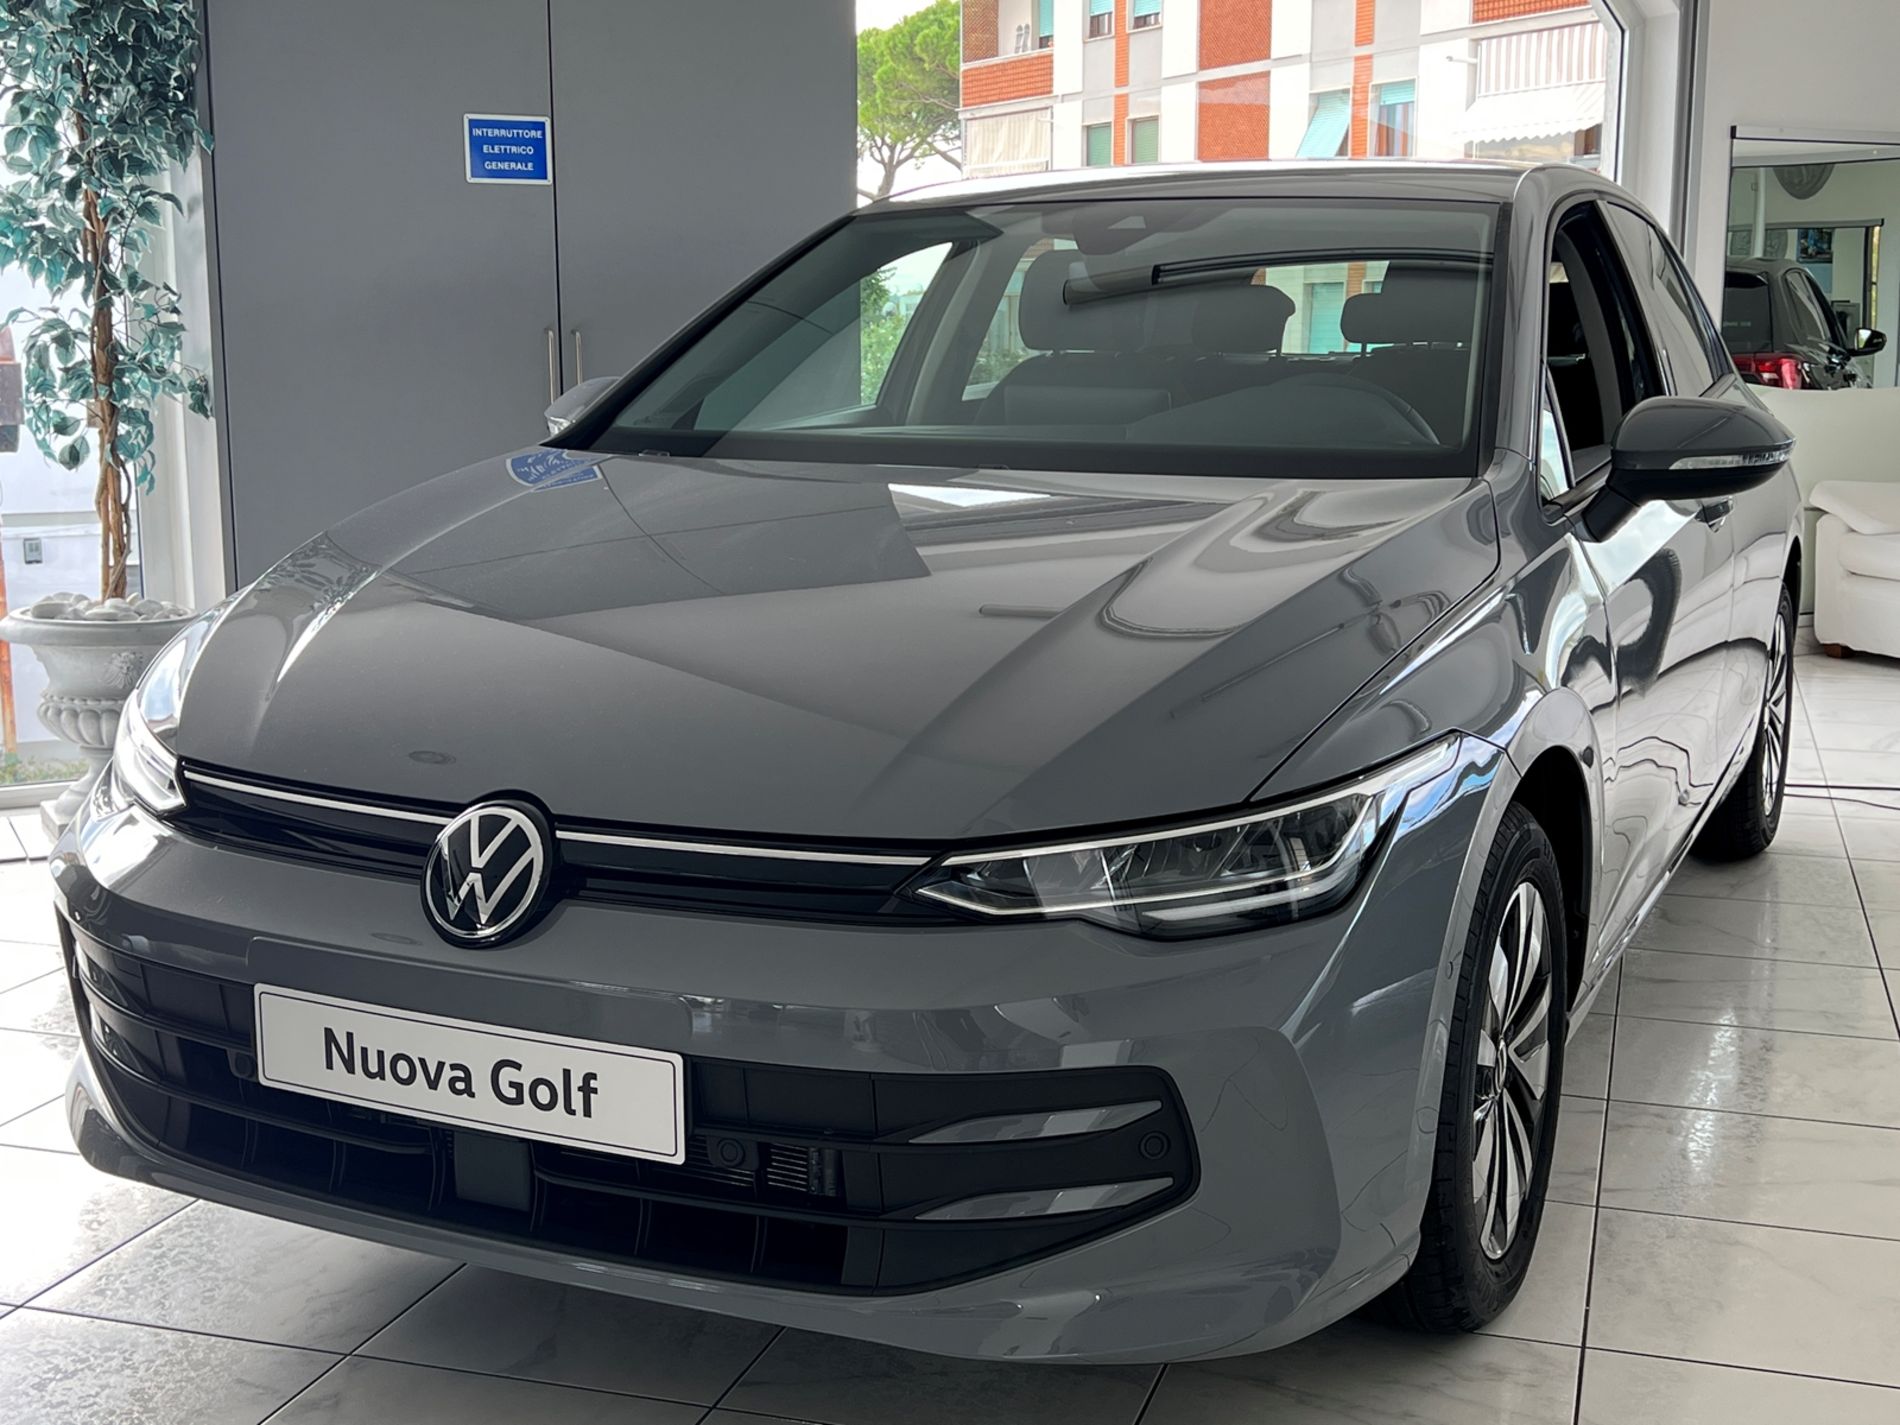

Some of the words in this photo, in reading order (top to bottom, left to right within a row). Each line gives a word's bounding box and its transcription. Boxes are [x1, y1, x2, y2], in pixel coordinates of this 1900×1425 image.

[472, 128, 543, 138] INTERRUTTORE
[482, 144, 534, 155] ELETTRICO
[484, 161, 534, 171] GENERALE
[323, 1026, 476, 1099] Nuova
[490, 1058, 599, 1119] Golf
